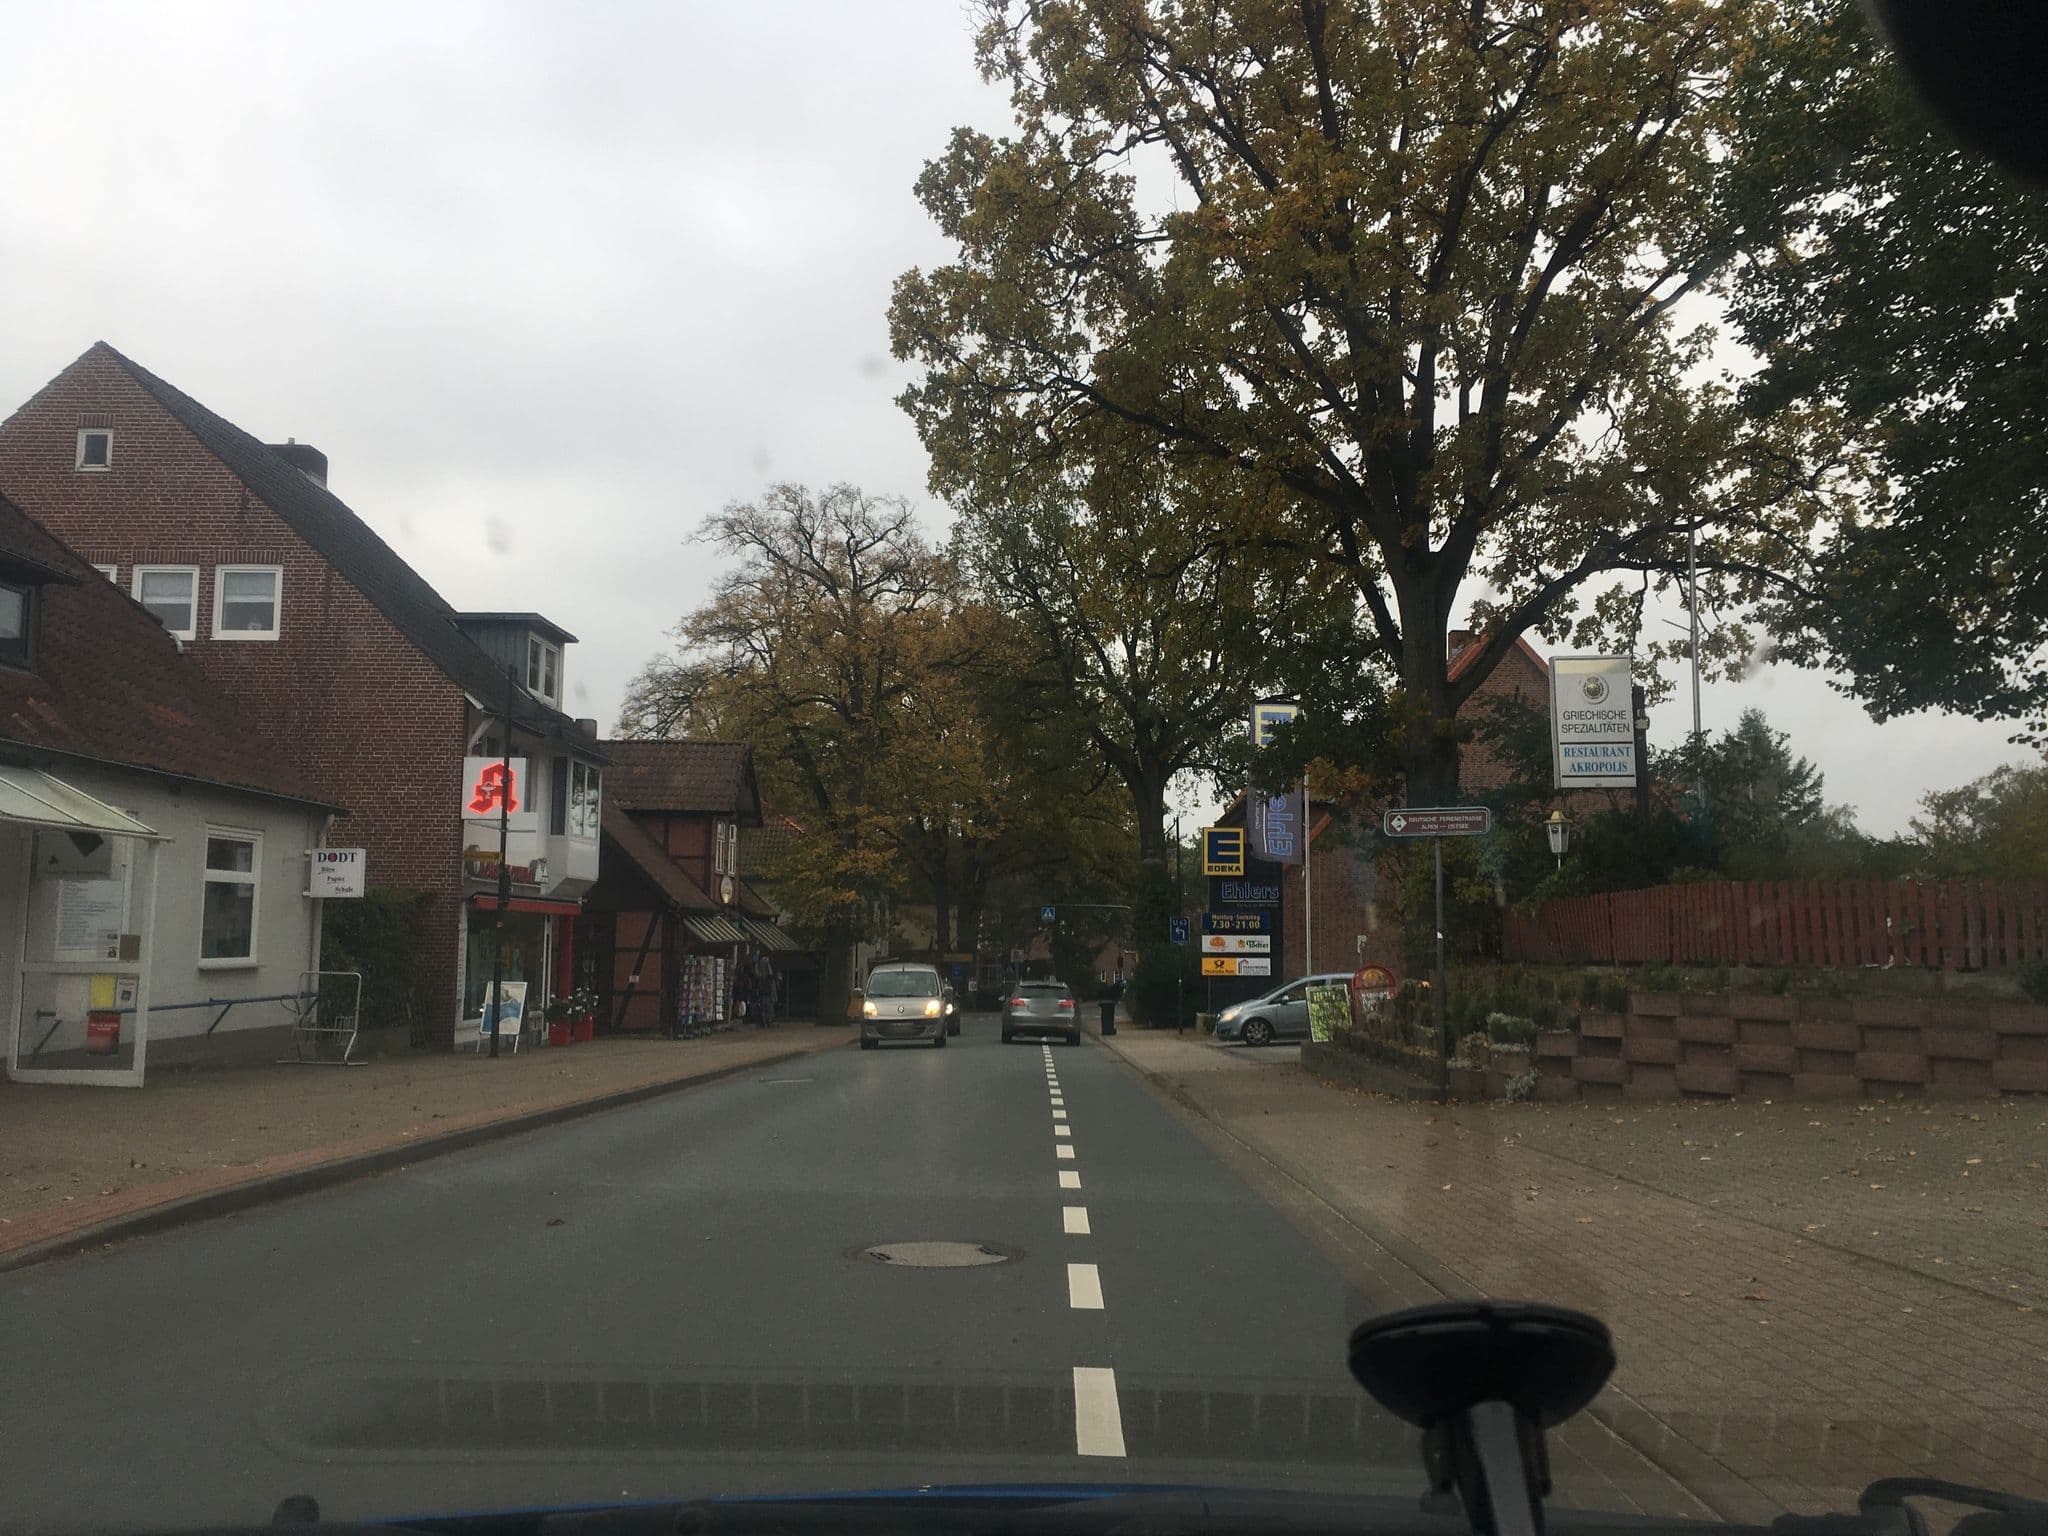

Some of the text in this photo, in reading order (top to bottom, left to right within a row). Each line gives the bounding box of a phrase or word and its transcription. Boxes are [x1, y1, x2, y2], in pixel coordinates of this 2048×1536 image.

[1562, 710, 1627, 721] GRIECHISCHE
[1561, 721, 1630, 734] SPEZIALITÄTEN
[1563, 746, 1632, 758] RESTAURANT
[1569, 761, 1628, 773] AKROPOLIS
[1221, 881, 1279, 899] Ehlers
